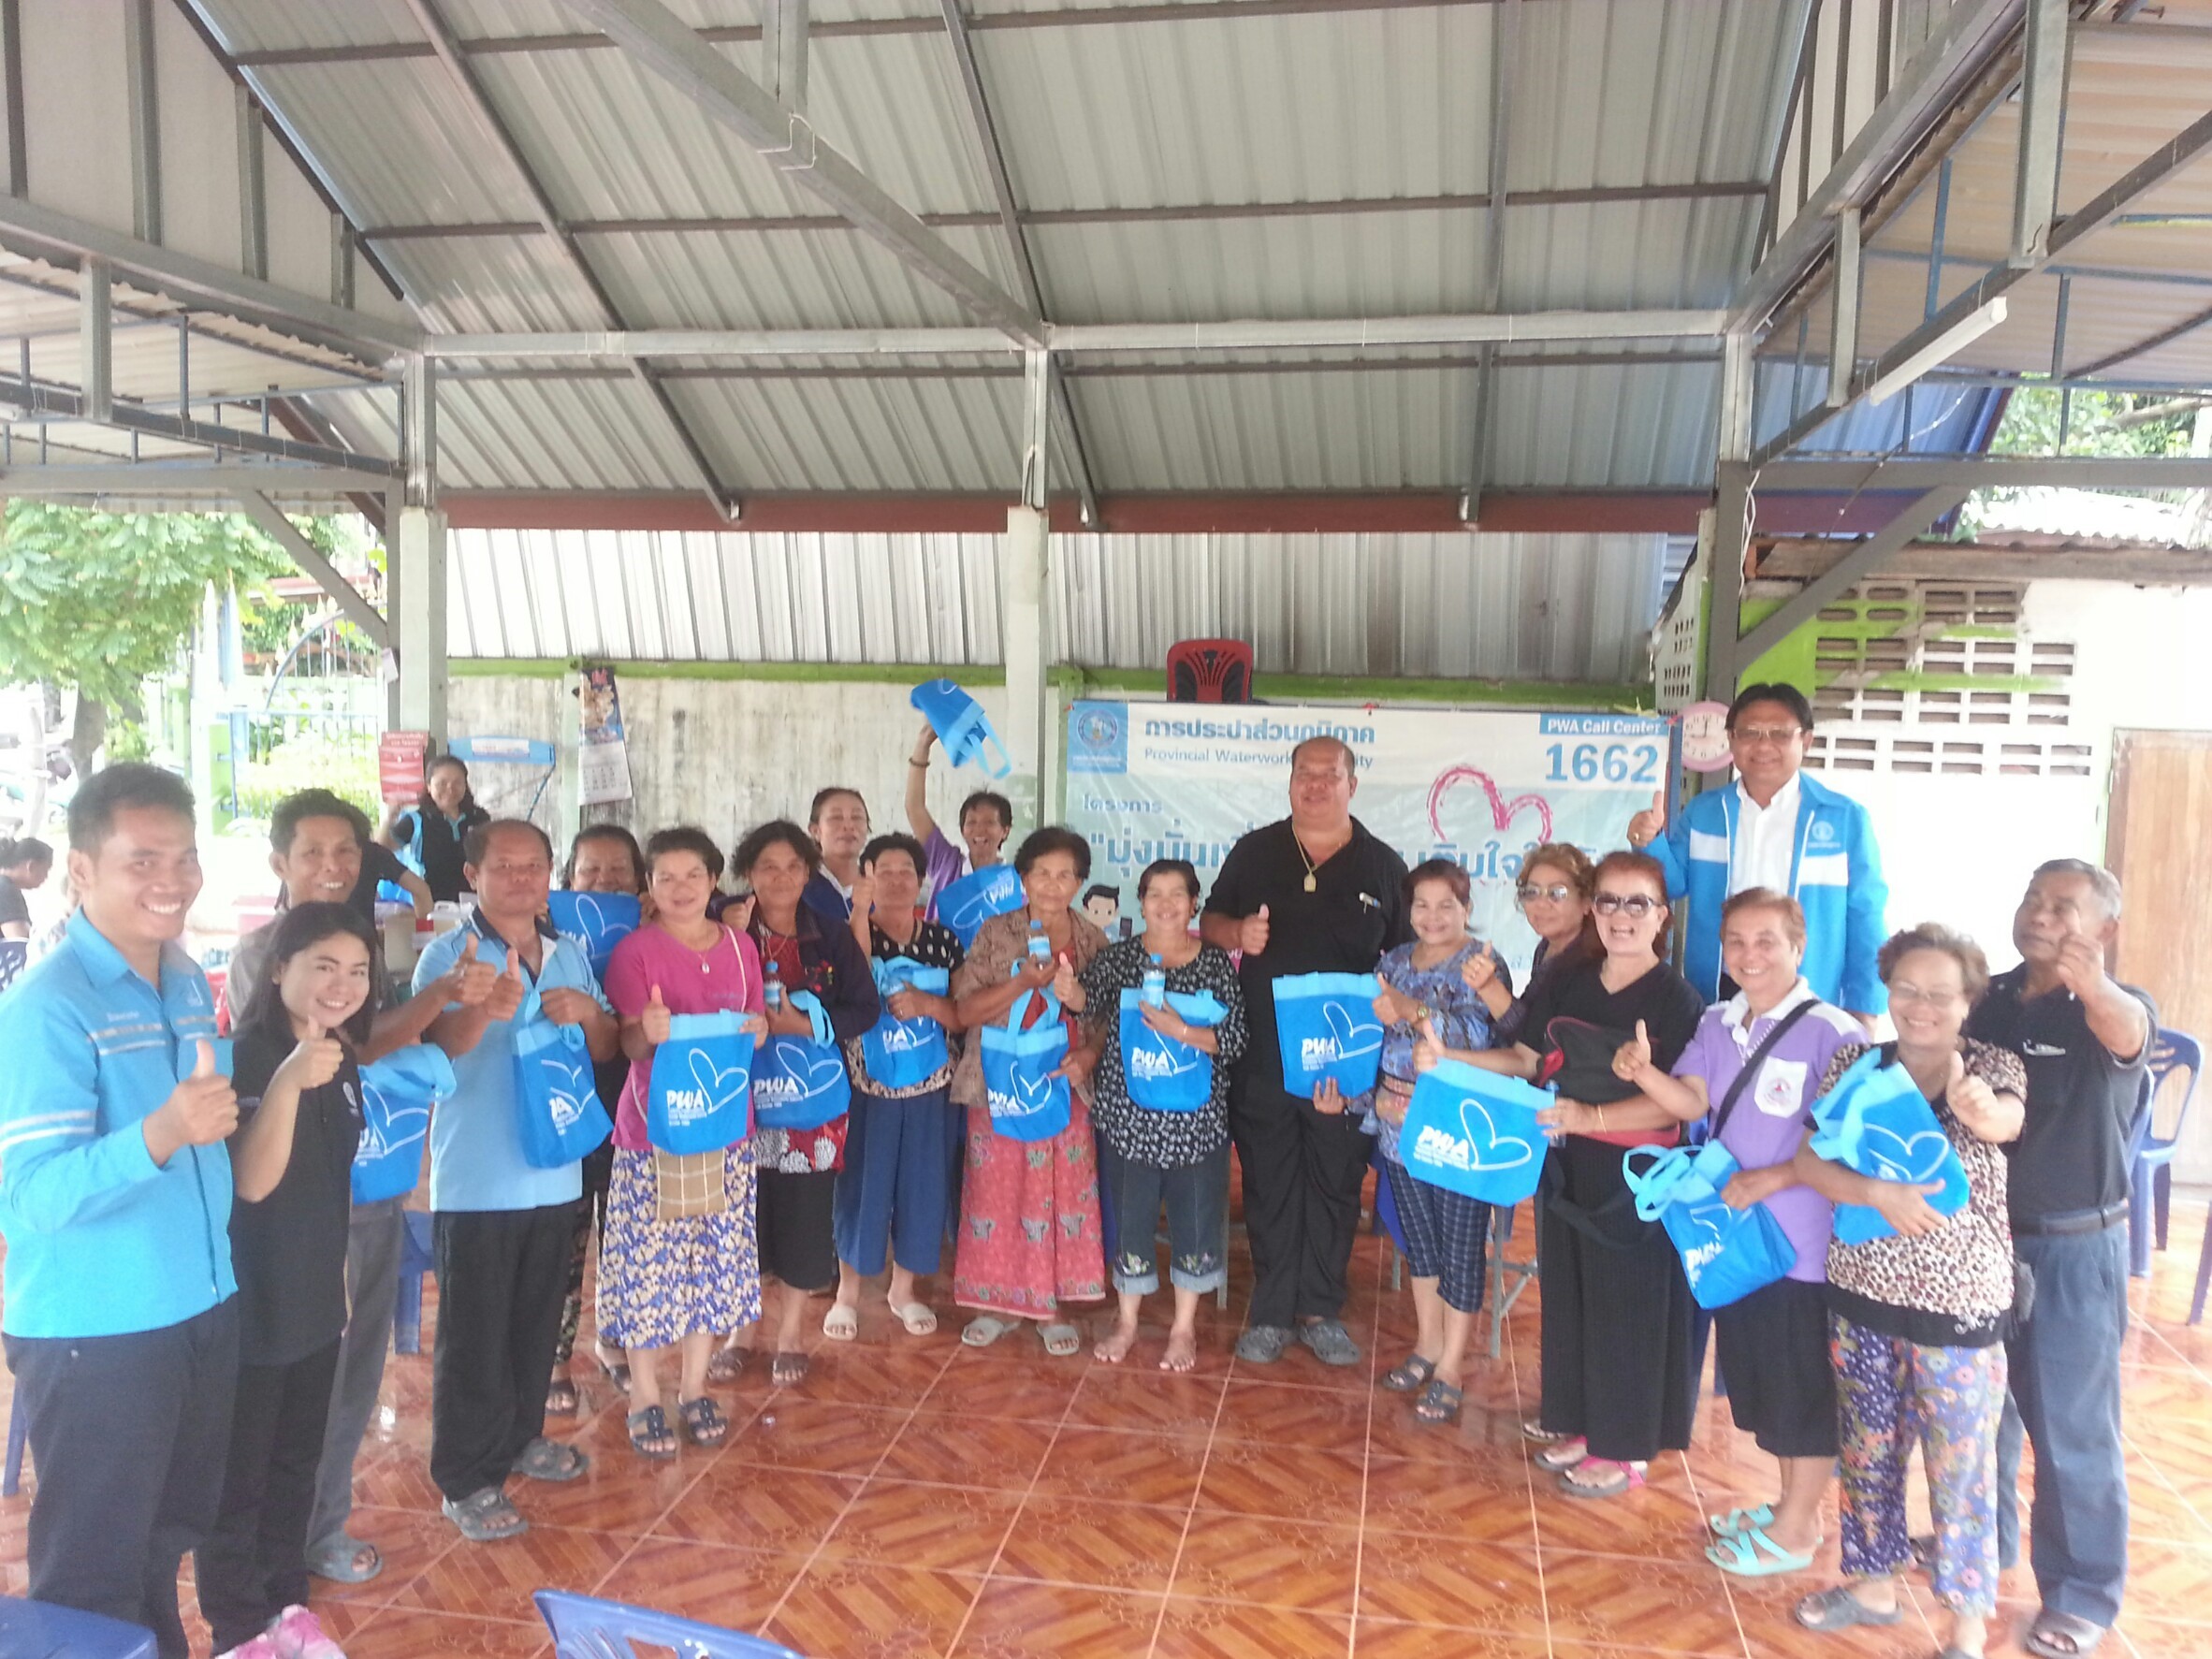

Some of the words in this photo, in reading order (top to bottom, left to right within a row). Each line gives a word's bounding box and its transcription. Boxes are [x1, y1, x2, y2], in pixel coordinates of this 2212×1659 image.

[1144, 718, 1375, 745] การประปาส่วนภมิภาค
[1548, 718, 1579, 733] PWA
[1582, 719, 1609, 734] Call
[1613, 720, 1662, 735] Center
[1144, 747, 1209, 763] Provincial
[1215, 749, 1292, 765] Waterwork
[1545, 742, 1658, 782] 1662
[1131, 1046, 1170, 1069] PWA
[1301, 1037, 1336, 1057] PWA
[753, 1076, 800, 1097] PWA
[667, 1088, 706, 1111] PWA
[1417, 1125, 1469, 1162] PWA
